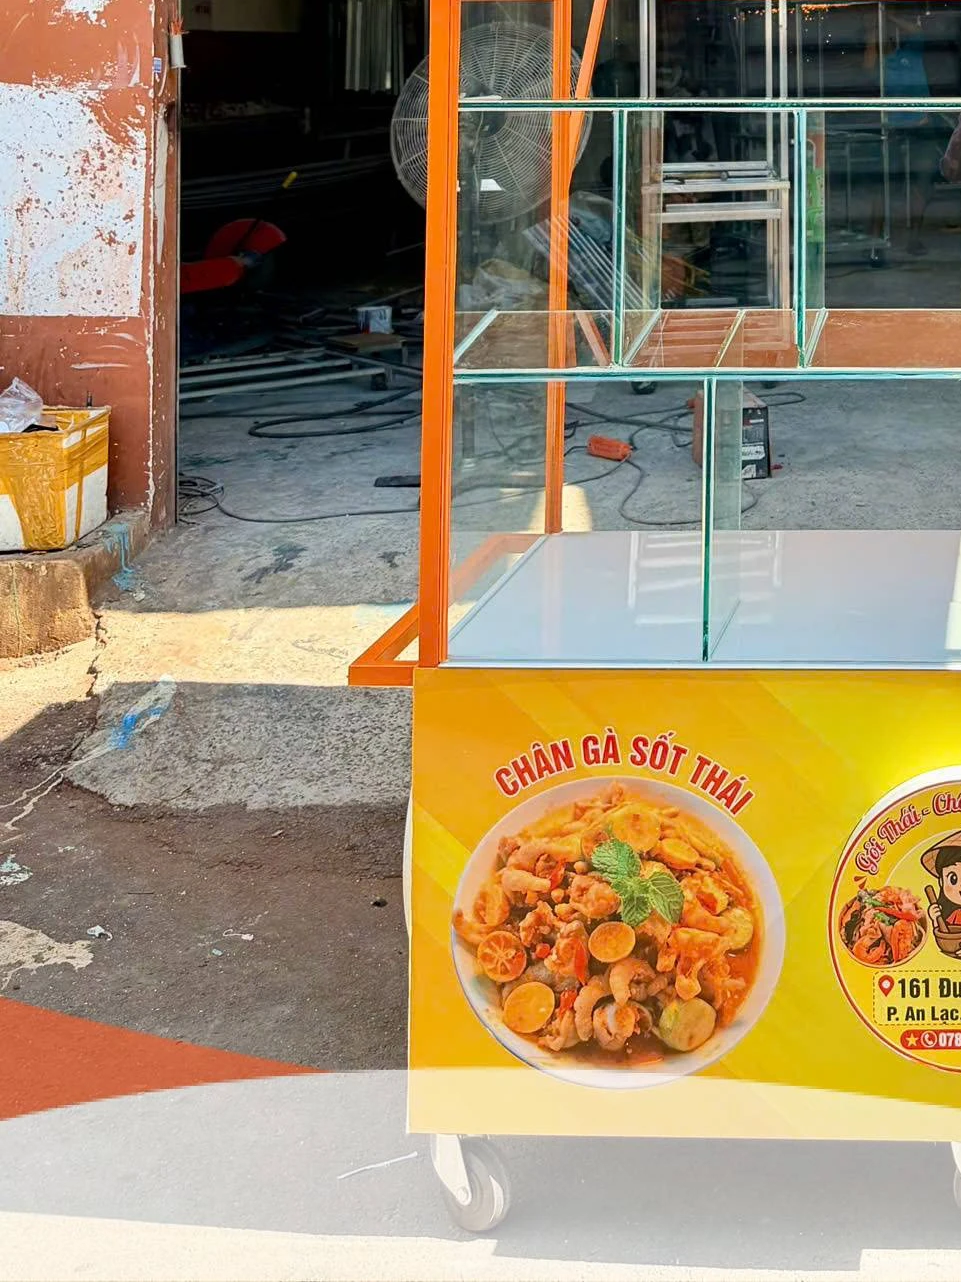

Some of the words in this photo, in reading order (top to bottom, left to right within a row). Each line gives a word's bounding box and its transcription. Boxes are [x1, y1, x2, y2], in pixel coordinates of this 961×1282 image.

[495, 743, 575, 797] CHÂN
[581, 728, 620, 765] GÀ
[630, 732, 687, 775] SỐT
[689, 754, 754, 815] THÁI
[855, 838, 886, 875] Gỏi
[877, 805, 923, 844] Thái
[897, 977, 930, 999] 161
[886, 1006, 900, 1022] P.
[904, 1006, 926, 1022] An
